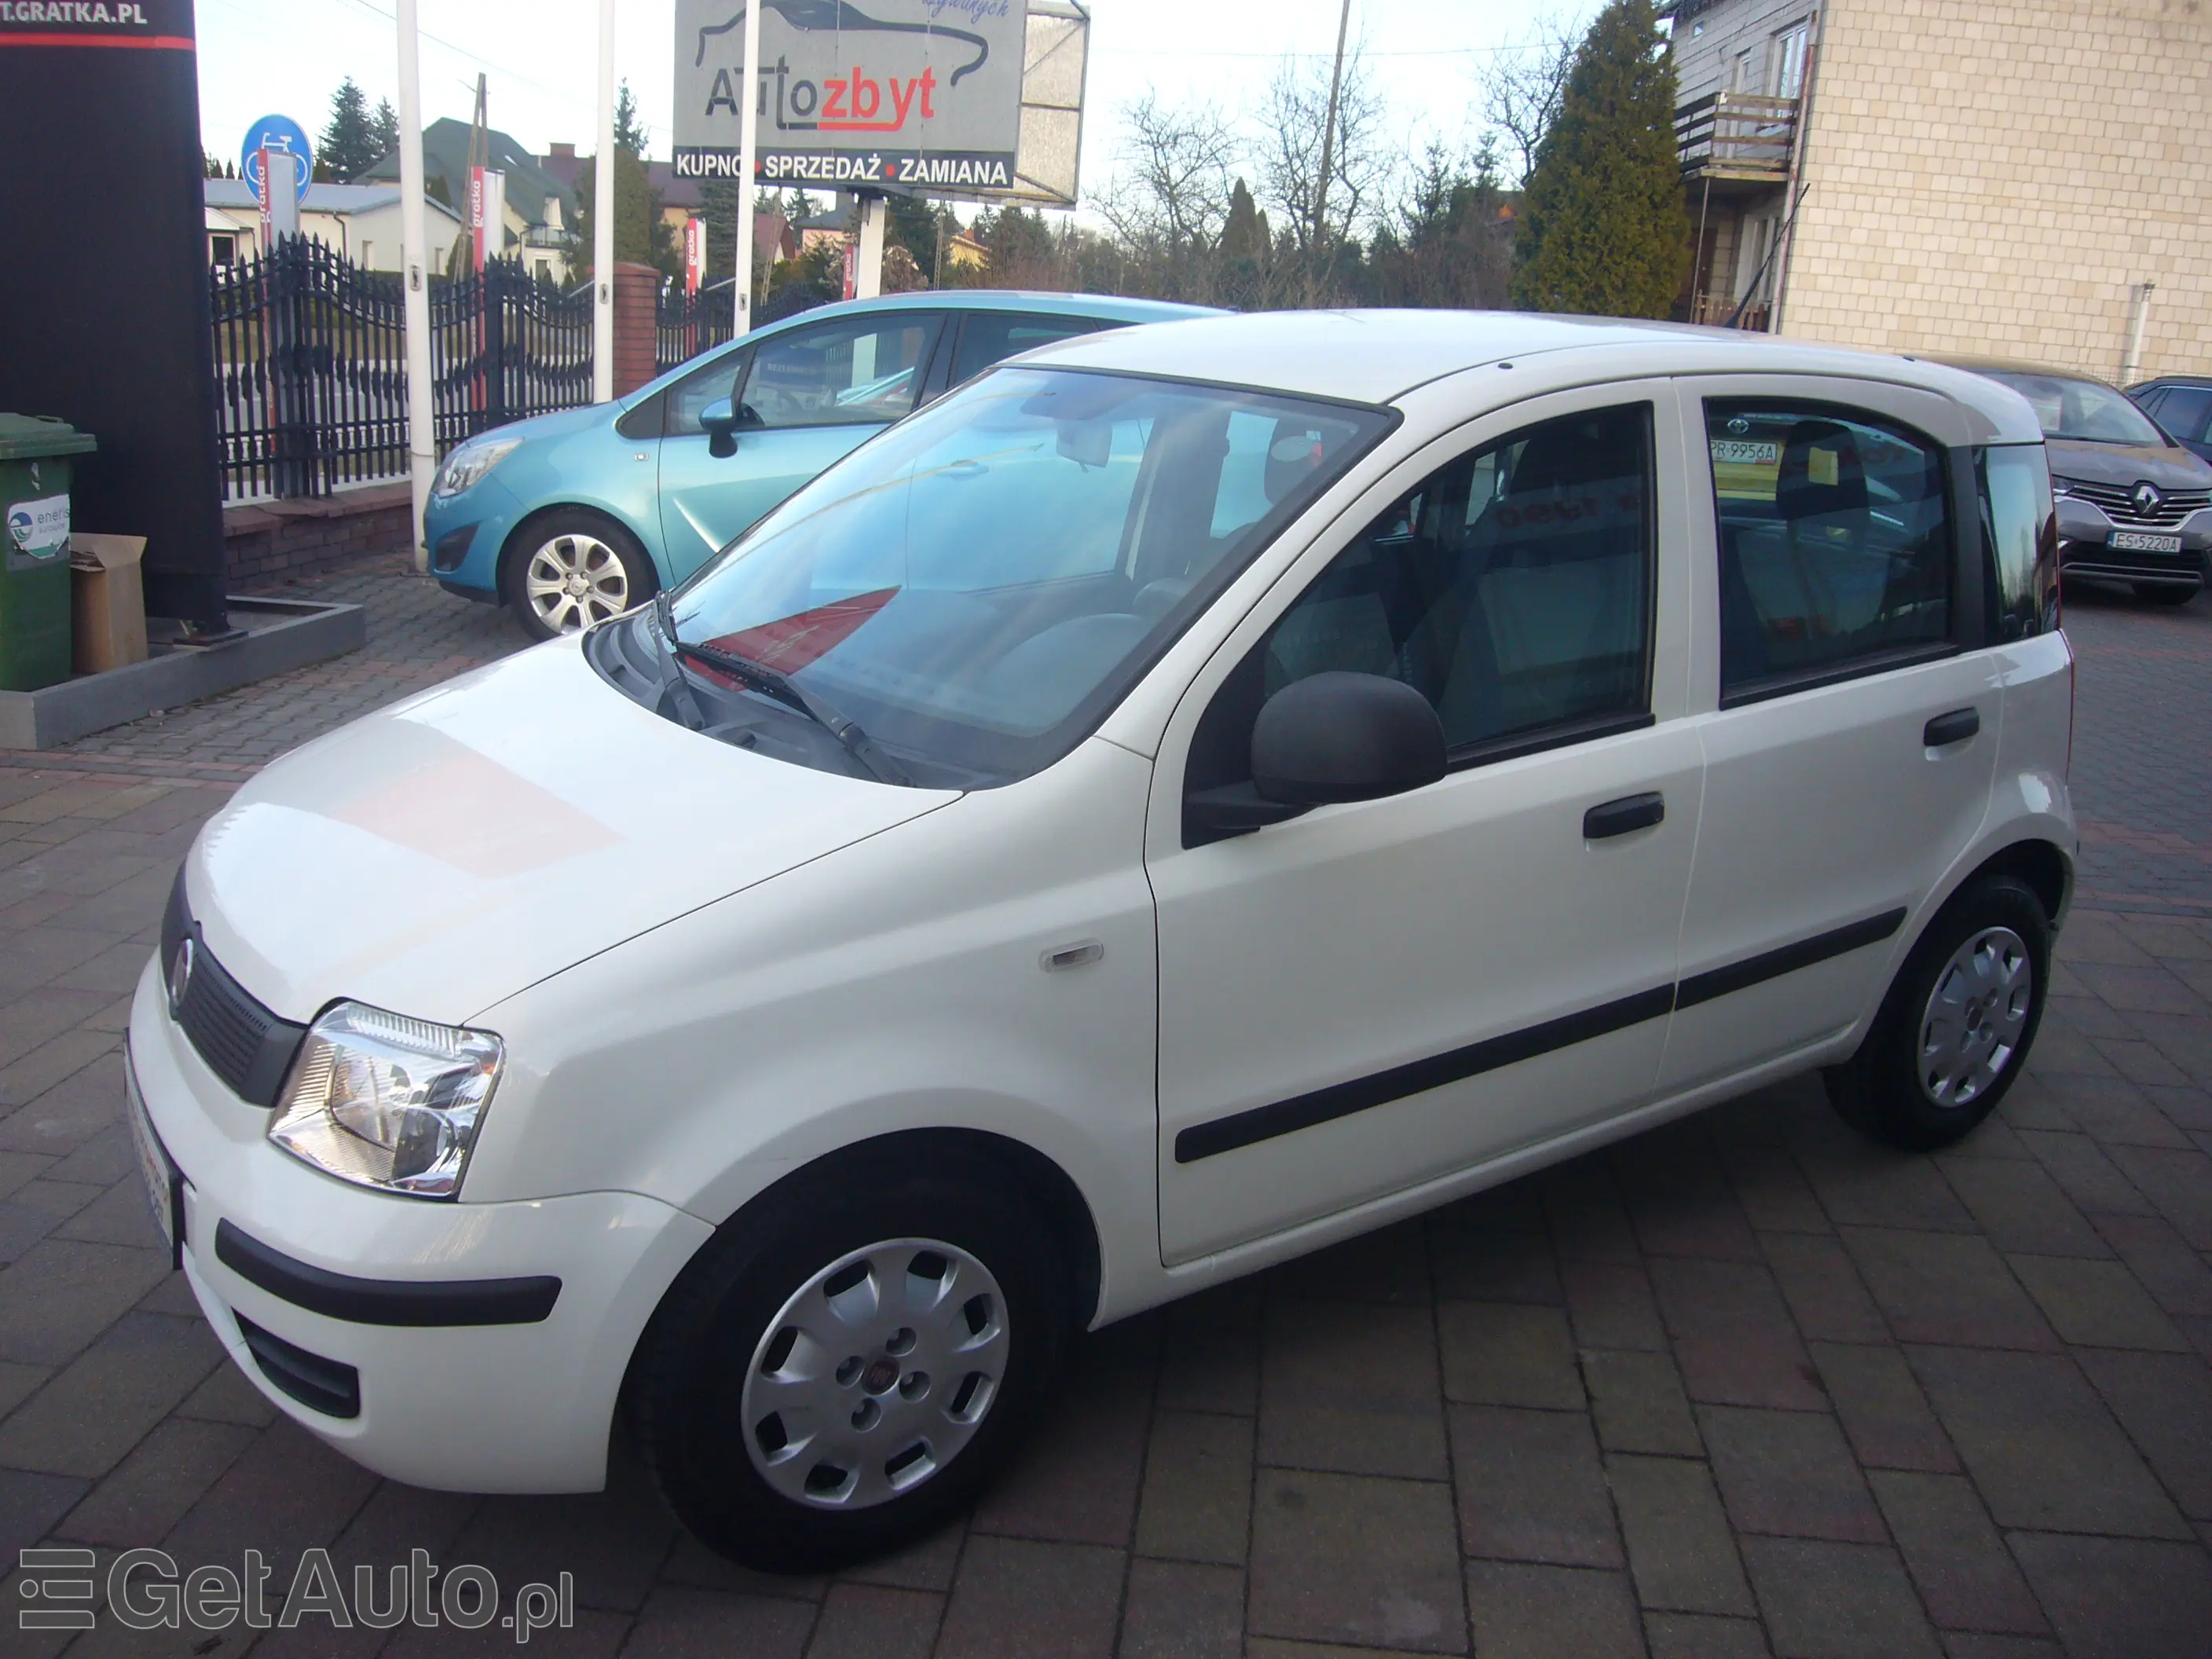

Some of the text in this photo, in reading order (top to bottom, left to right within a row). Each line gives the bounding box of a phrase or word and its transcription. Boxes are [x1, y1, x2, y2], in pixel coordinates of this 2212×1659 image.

[764, 152, 881, 181] SPRZEDAŻ
[899, 158, 1008, 185] ZAMIANA
[471, 181, 484, 228] gratka
[1730, 442, 1774, 460] 9956A
[2116, 534, 2177, 551] ES 5220A
